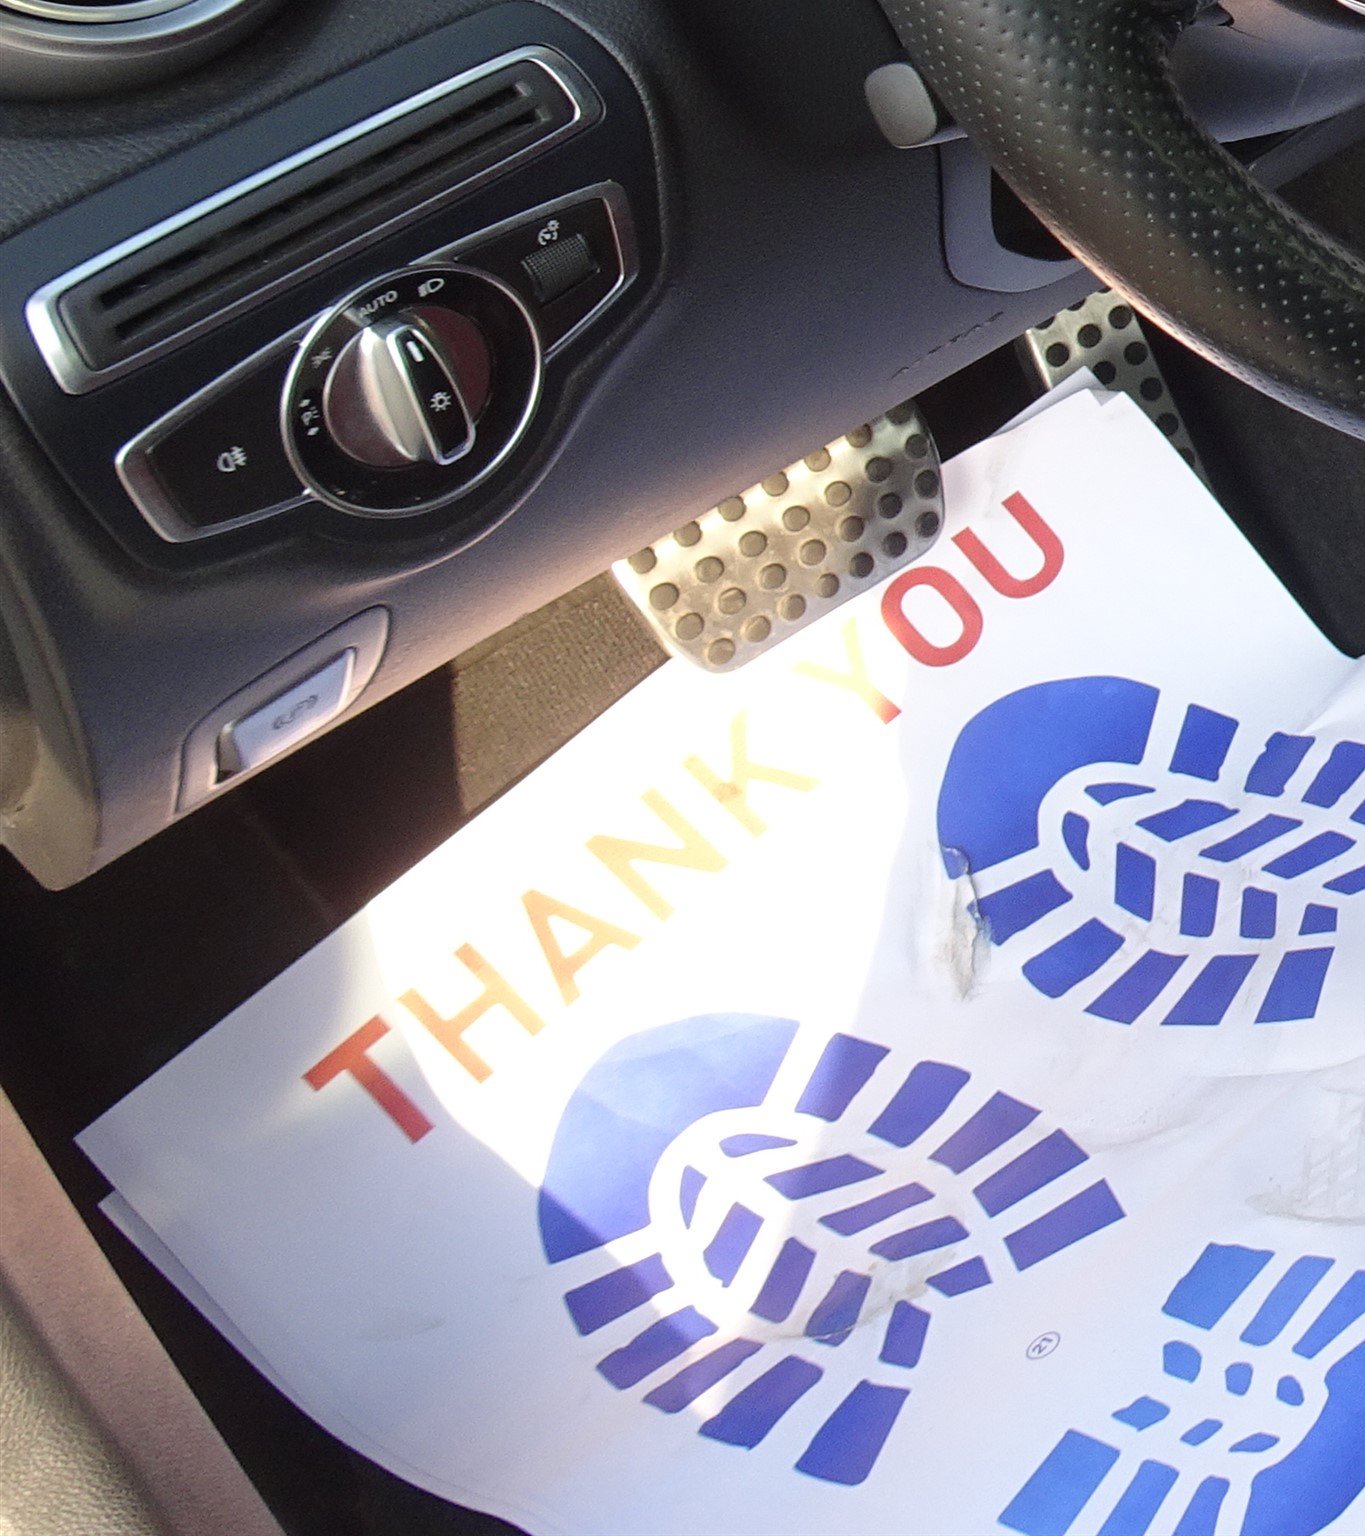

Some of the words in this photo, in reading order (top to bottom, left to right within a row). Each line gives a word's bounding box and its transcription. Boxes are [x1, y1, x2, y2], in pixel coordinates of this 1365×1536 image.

[359, 290, 399, 319] AUTO
[299, 708, 819, 1145] THANK
[796, 490, 1065, 726] YOU
